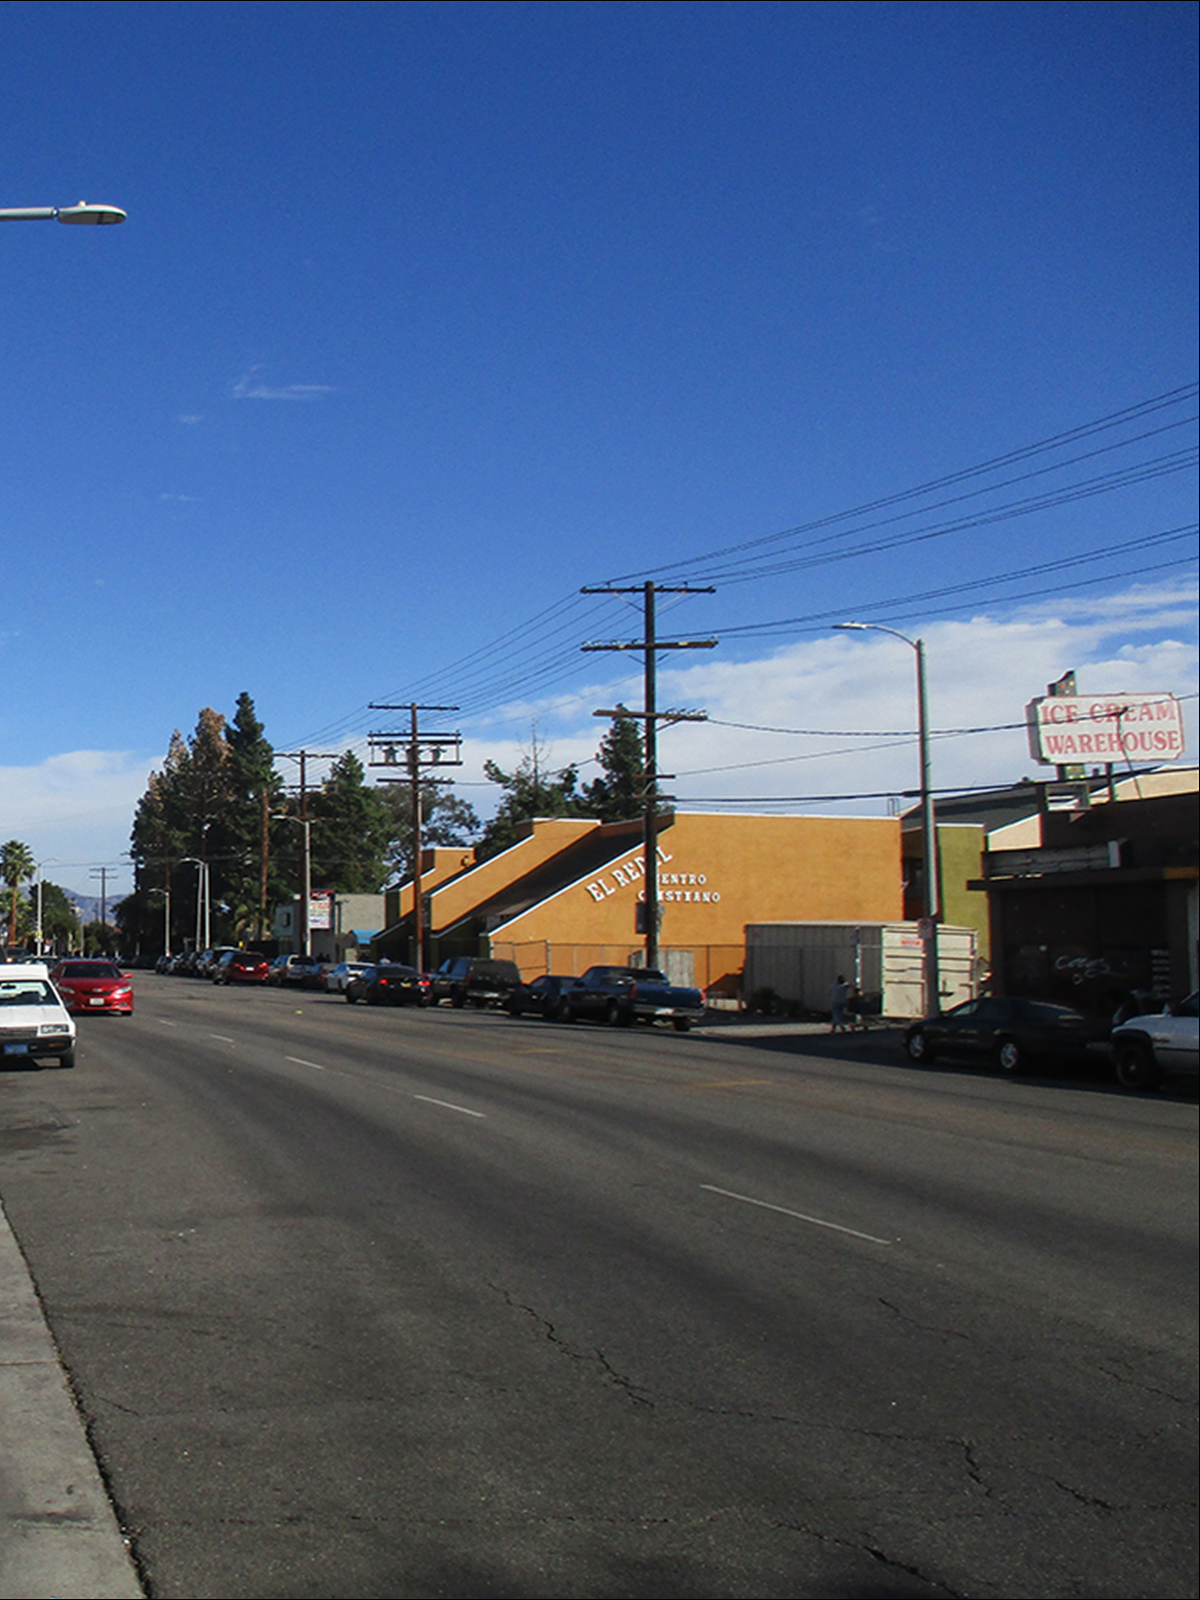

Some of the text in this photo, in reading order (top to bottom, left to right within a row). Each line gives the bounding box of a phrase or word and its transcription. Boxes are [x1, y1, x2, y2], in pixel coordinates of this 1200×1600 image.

[1041, 702, 1176, 724] ICE CREAM
[1045, 730, 1180, 755] WAREHOUSE
[586, 846, 673, 902] EL REDL
[656, 873, 707, 886] ENTRO
